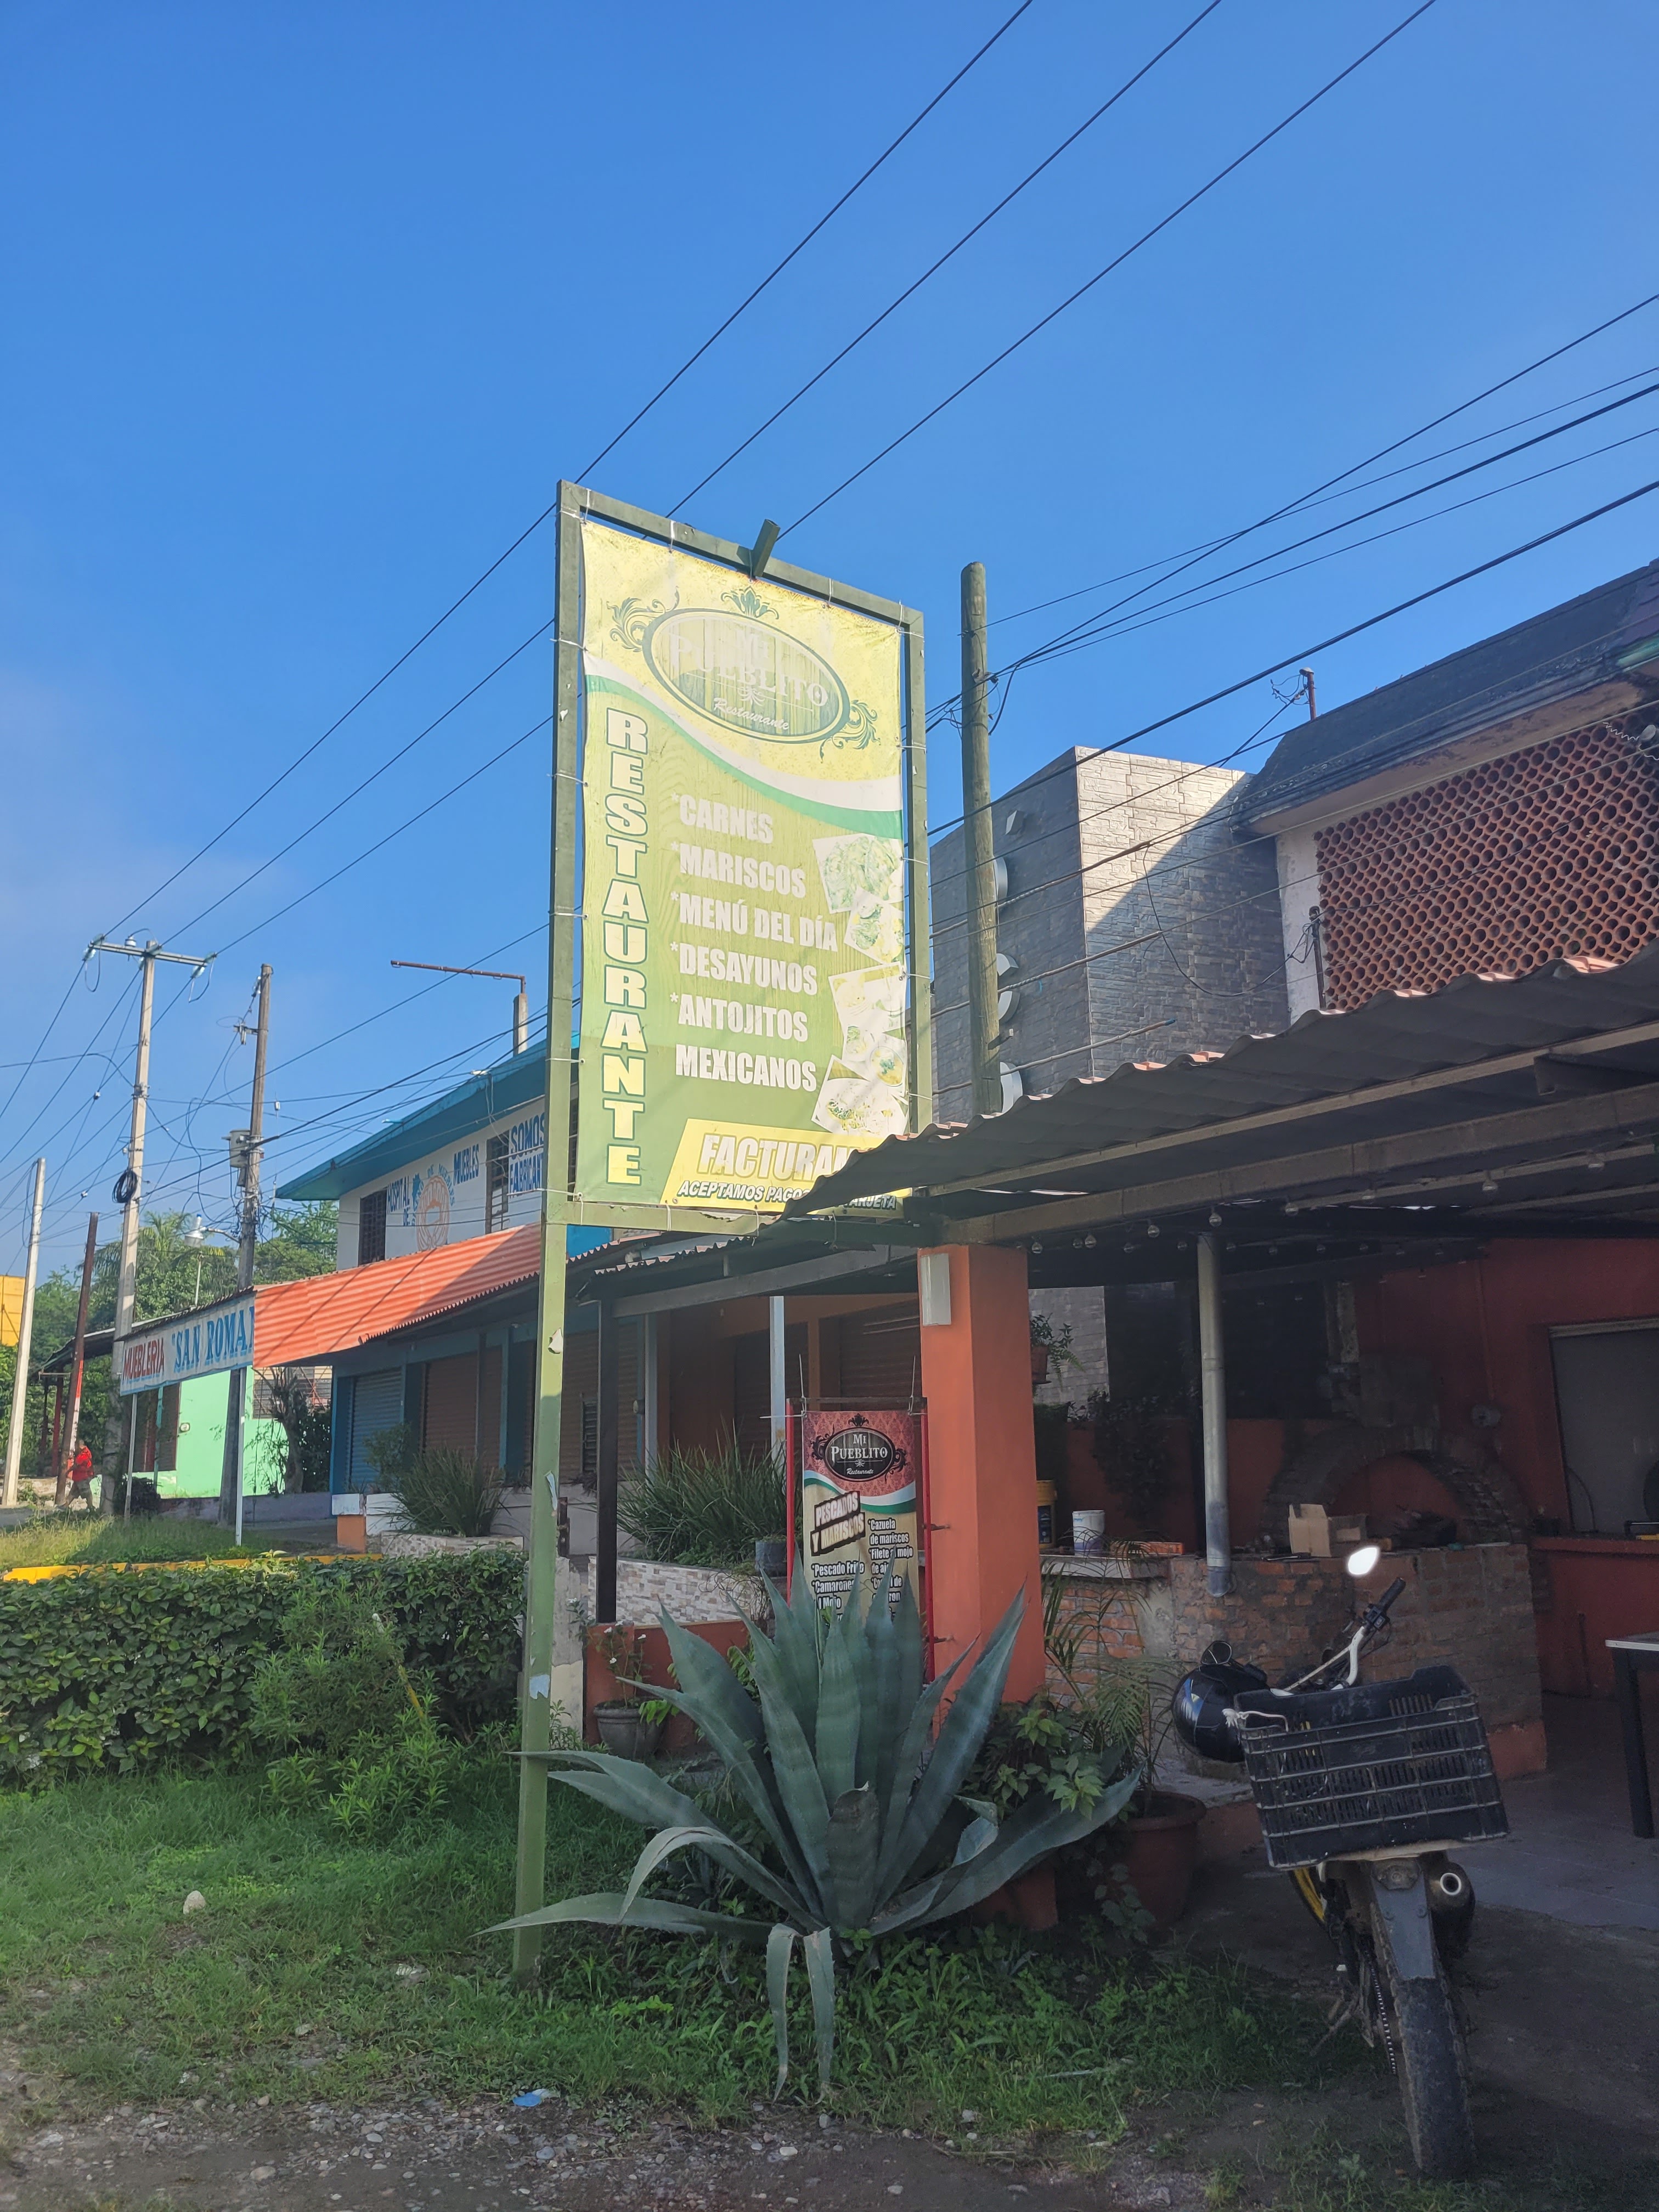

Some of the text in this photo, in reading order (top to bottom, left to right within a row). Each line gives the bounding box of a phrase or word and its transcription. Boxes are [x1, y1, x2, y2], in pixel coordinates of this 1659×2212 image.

[713, 697, 789, 730] Restaurante
[680, 794, 773, 844] CARNES
[680, 843, 806, 898] MARISCOS
[680, 892, 838, 952] MENÚ DEL DÍA
[601, 708, 649, 1186] RESTAURANTE
[679, 943, 817, 996] DESAYUNOS
[678, 994, 808, 1042] ANTOJITOS
[676, 1043, 817, 1092] MEXICANOS
[511, 1112, 545, 1160] SOMOS
[453, 1143, 479, 1186] MUEBLES
[387, 1176, 410, 1214] HOSPITAL
[678, 1181, 765, 1203] ACEPTAMOS
[122, 1338, 165, 1383] MUEBLERIA
[846, 1467, 874, 1475] Restaurante
[815, 1491, 859, 1527] PESCADOS
[871, 1519, 896, 1531] Cazuela
[811, 1513, 865, 1553] Y MARISCOS
[870, 1533, 909, 1545] de mariscos
[815, 1562, 845, 1576] Pescado
[871, 1564, 879, 1574] de
[872, 1548, 889, 1559] Filete
[897, 1547, 913, 1558] mojo
[894, 1576, 902, 1587] de
